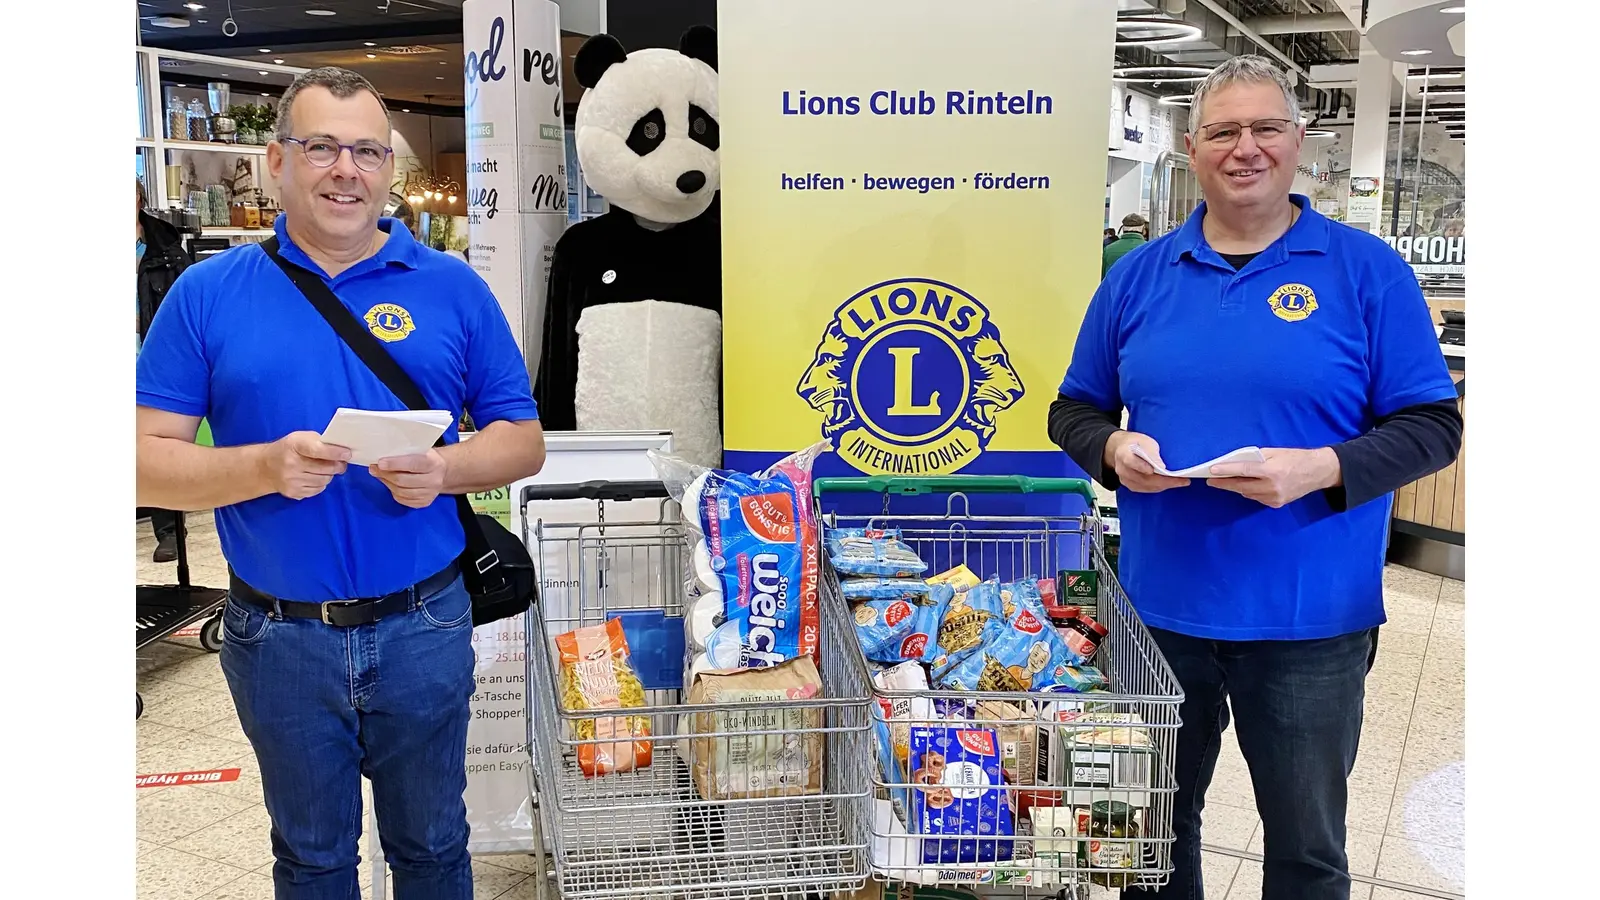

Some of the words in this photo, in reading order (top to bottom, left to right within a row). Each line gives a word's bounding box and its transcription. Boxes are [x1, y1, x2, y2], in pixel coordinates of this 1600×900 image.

[781, 91, 860, 116] Lions
[869, 90, 936, 116] Club
[945, 90, 1053, 115] Rinteln
[780, 173, 845, 190] helfen
[863, 174, 955, 193] bewegen
[973, 173, 1050, 190] fördern
[1282, 285, 1310, 295] LIONS
[1286, 295, 1300, 309] L
[377, 305, 406, 317] LIONS
[847, 287, 977, 333] LIONS
[383, 313, 398, 328] L
[886, 347, 941, 416] L
[846, 437, 972, 474] INTERNATIONAL
[749, 500, 790, 535] GÜNSTIG
[804, 625, 817, 643] 20
[489, 676, 503, 684] an
[476, 708, 525, 720] Shopper!
[466, 745, 482, 755] sie
[484, 743, 514, 754] dafür
[183, 771, 222, 781] Bitte
